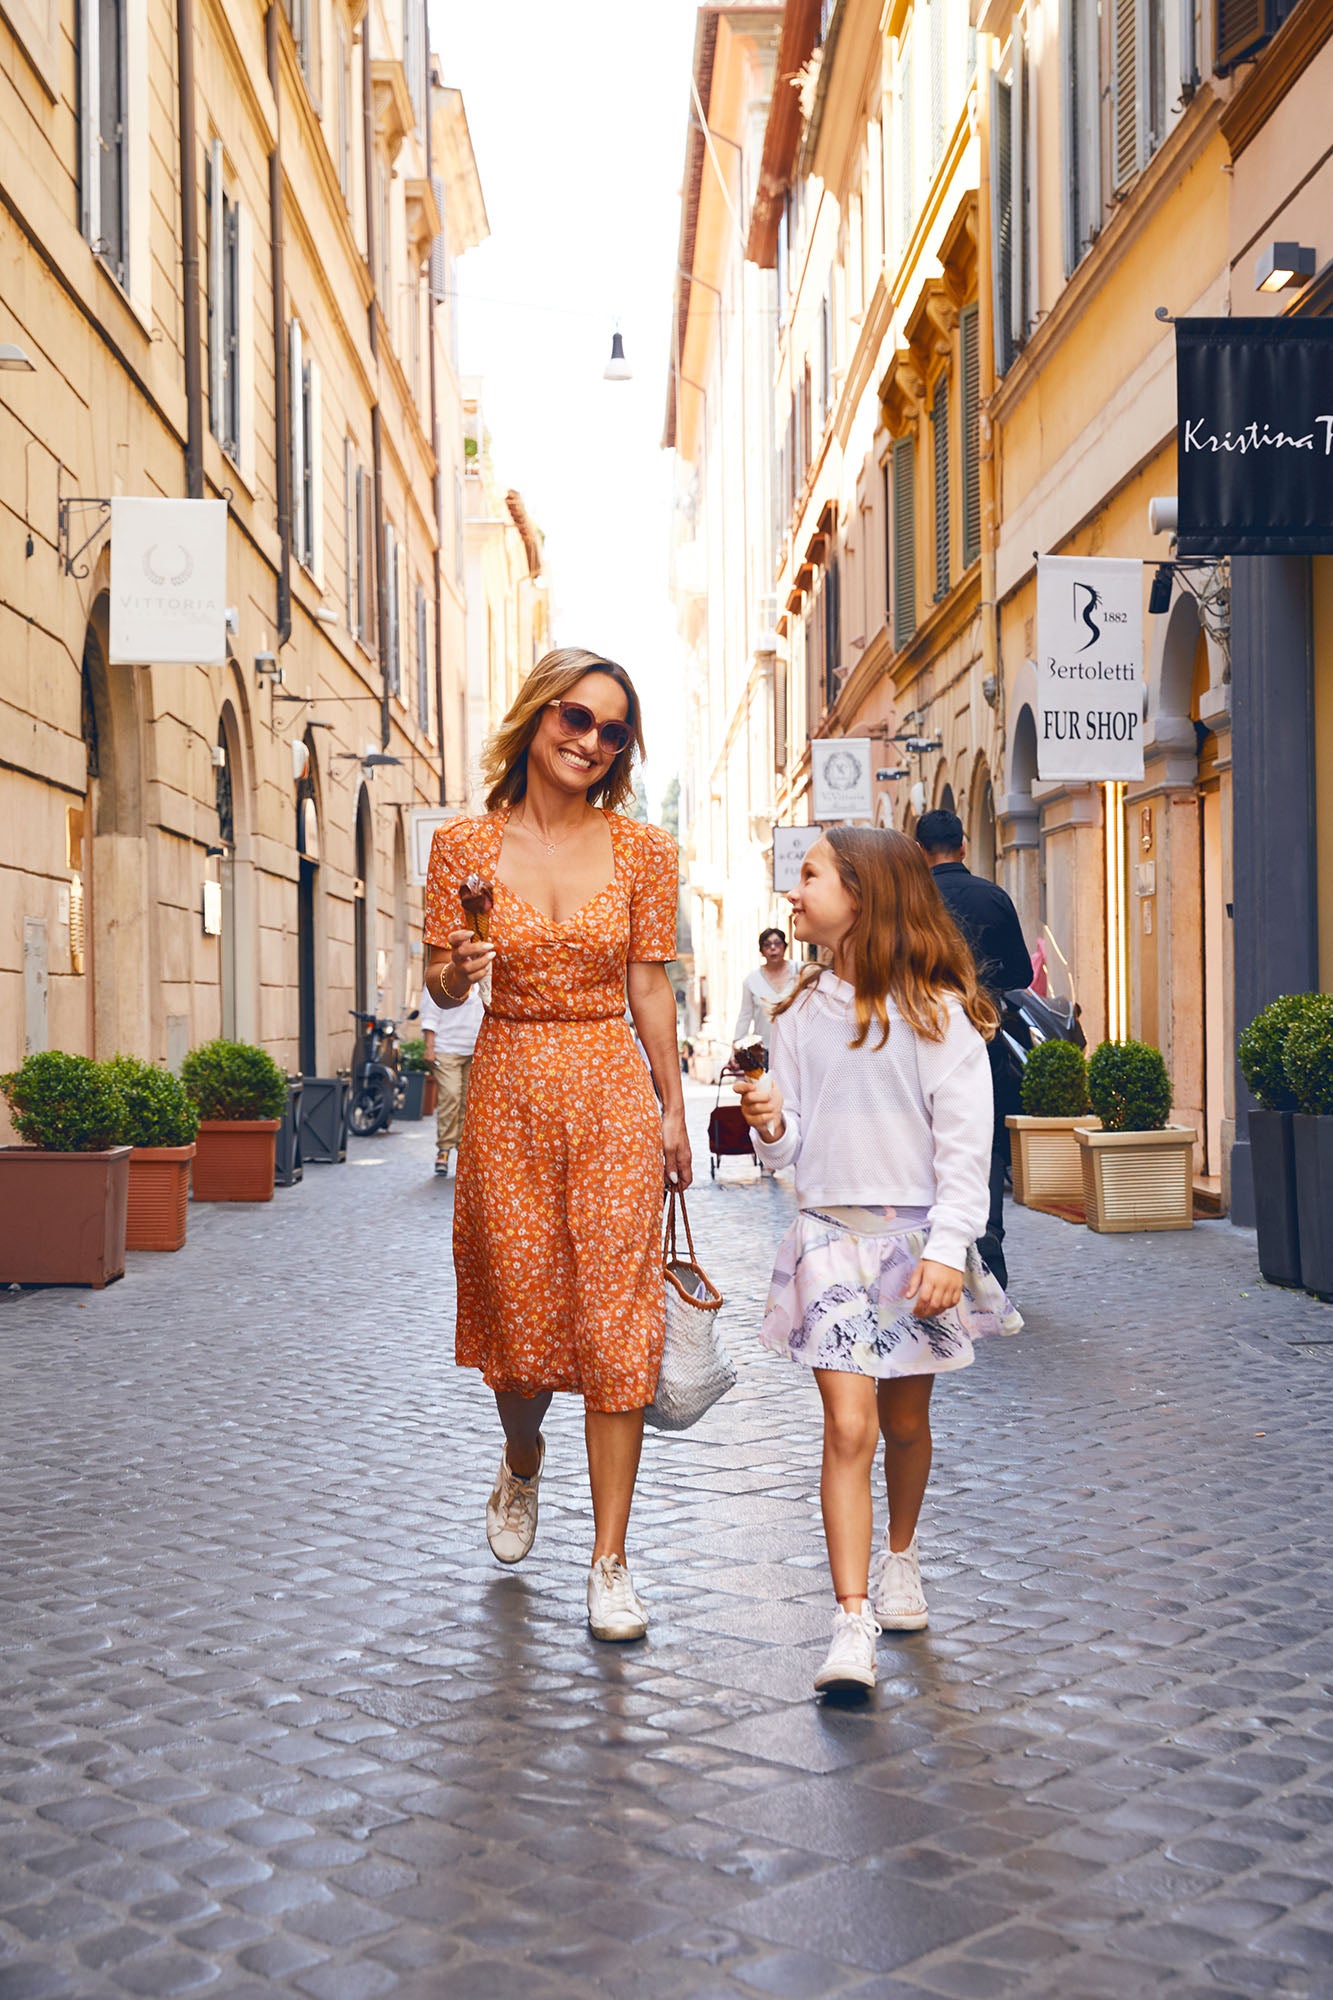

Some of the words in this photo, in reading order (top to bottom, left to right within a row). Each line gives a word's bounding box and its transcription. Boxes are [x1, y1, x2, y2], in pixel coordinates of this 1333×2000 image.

[1185, 417, 1314, 455] Kristina
[1315, 415, 1333, 455] T
[1104, 612, 1128, 624] 1882
[1047, 656, 1135, 681] Bertoletti
[1043, 710, 1082, 740] FUR
[1086, 711, 1138, 741] SHOP
